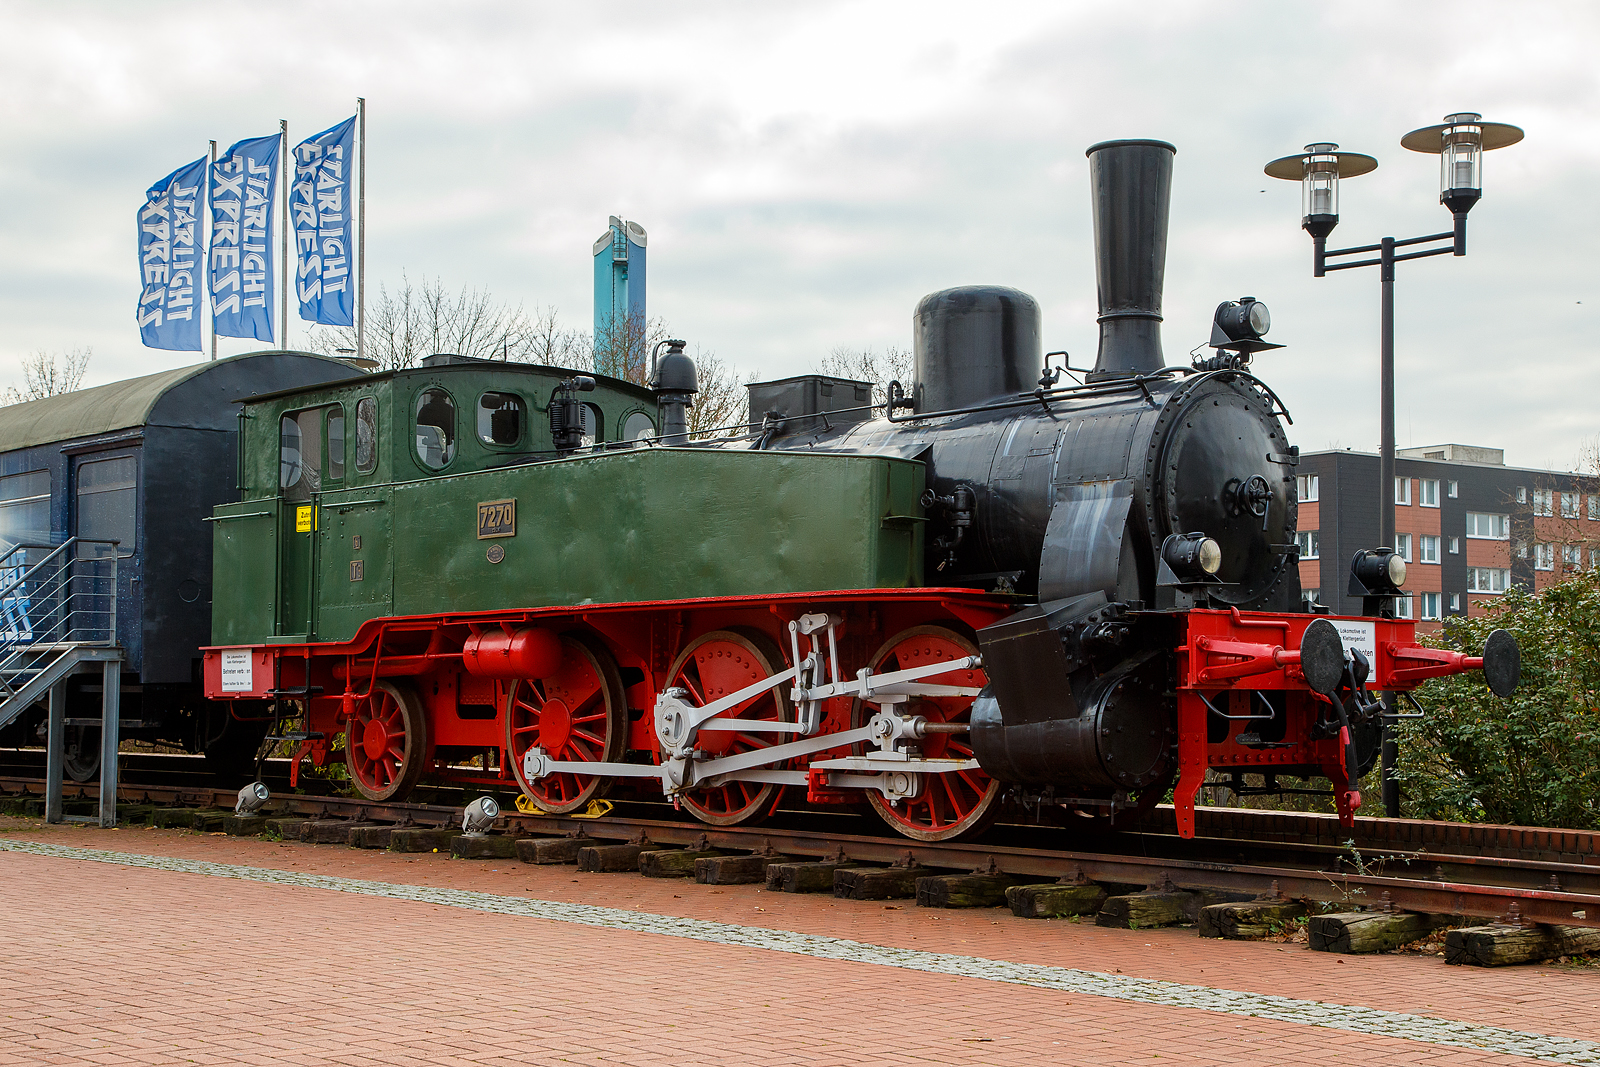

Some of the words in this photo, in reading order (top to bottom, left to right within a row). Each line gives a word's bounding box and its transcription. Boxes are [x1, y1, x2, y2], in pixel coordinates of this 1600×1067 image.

[138, 191, 171, 329] XPRESS
[166, 182, 199, 322] STARLIGHT
[210, 155, 244, 317] EXPRESS
[242, 156, 270, 309] STARLIGHT
[293, 141, 323, 305] EXPRESS
[315, 143, 349, 295] STARLIGHT
[480, 505, 512, 528] 7270
